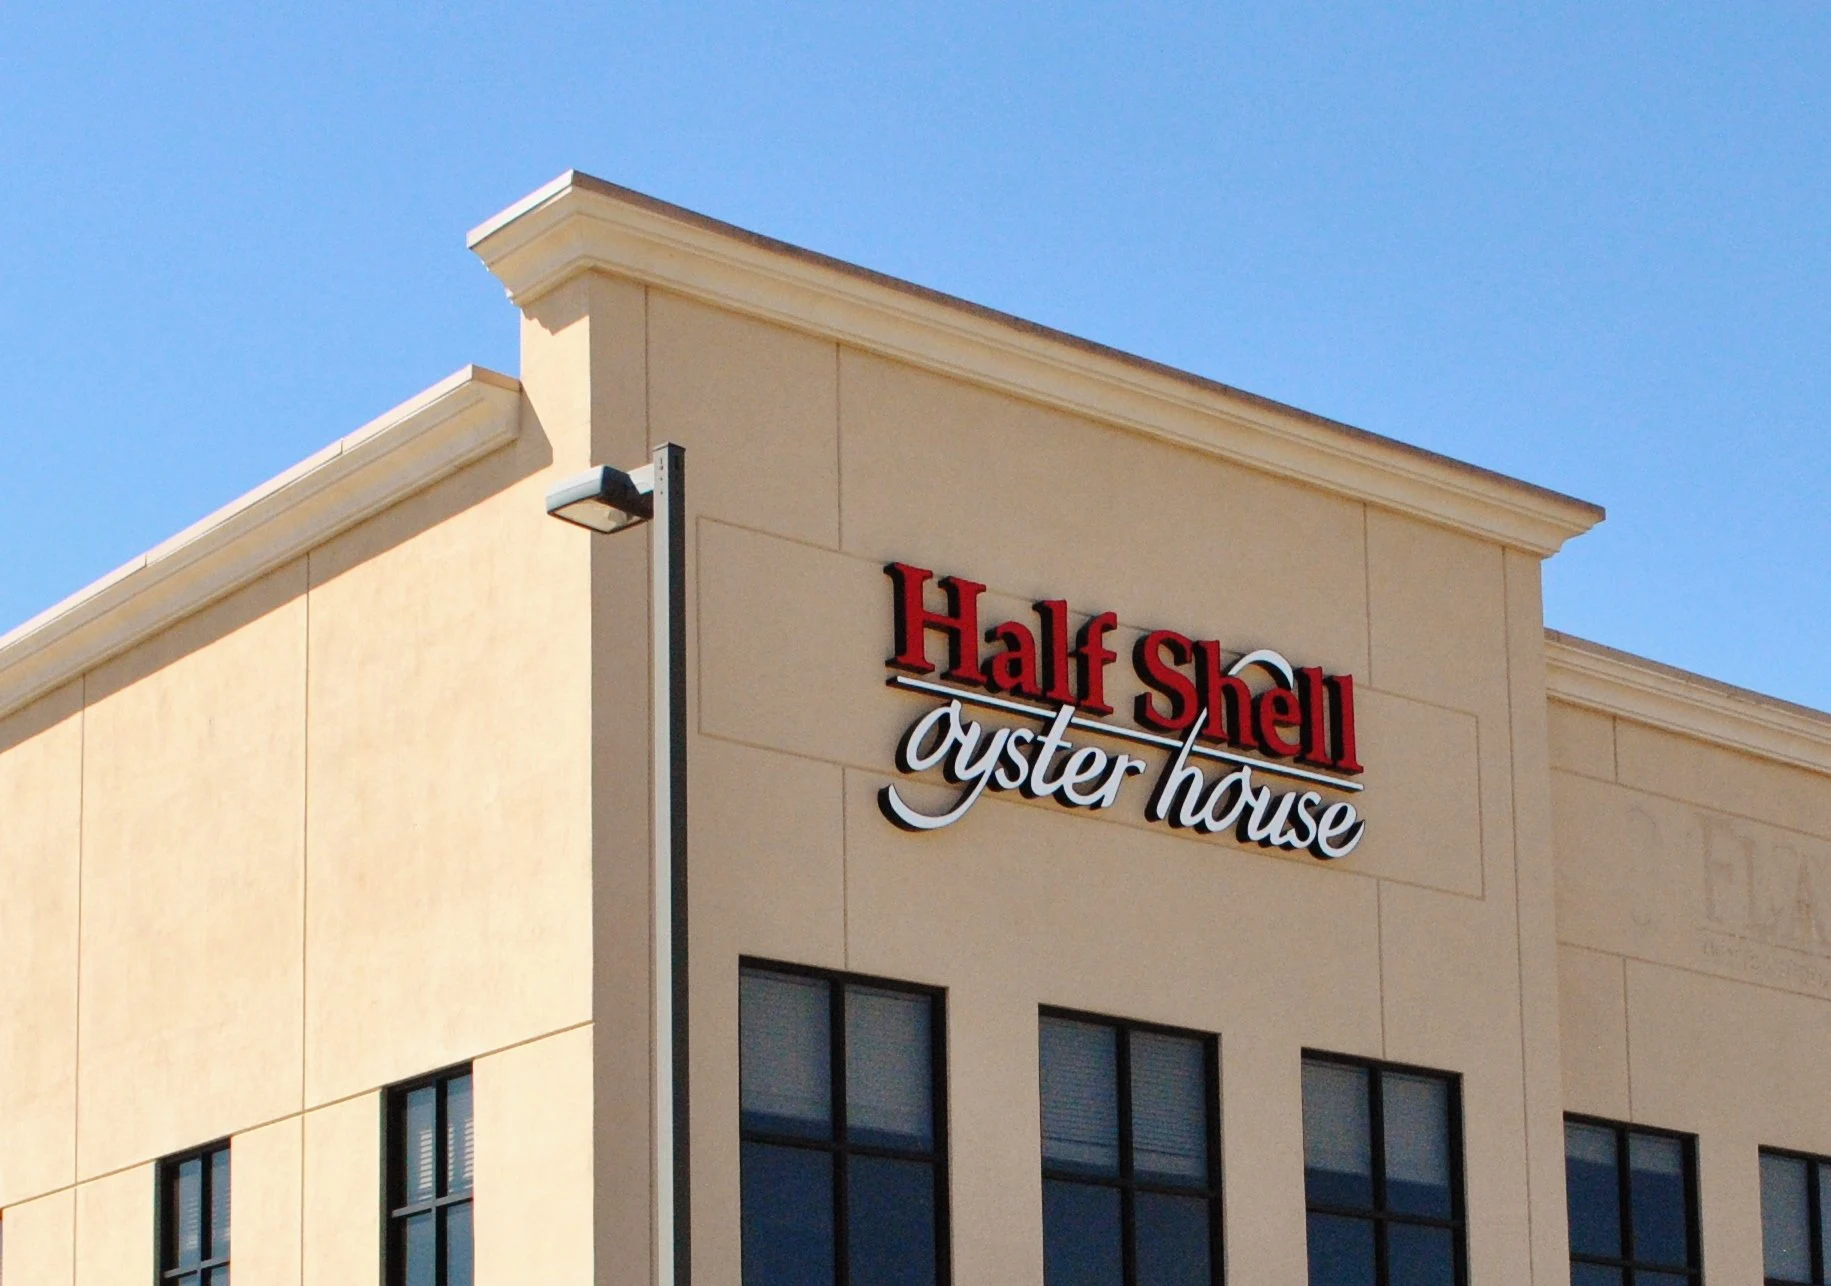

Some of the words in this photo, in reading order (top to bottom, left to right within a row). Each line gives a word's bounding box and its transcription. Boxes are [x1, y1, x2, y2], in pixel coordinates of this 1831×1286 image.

[884, 562, 1118, 714] Half
[1133, 629, 1364, 774] Shell
[879, 699, 1146, 832] oyster
[1146, 707, 1366, 860] house
